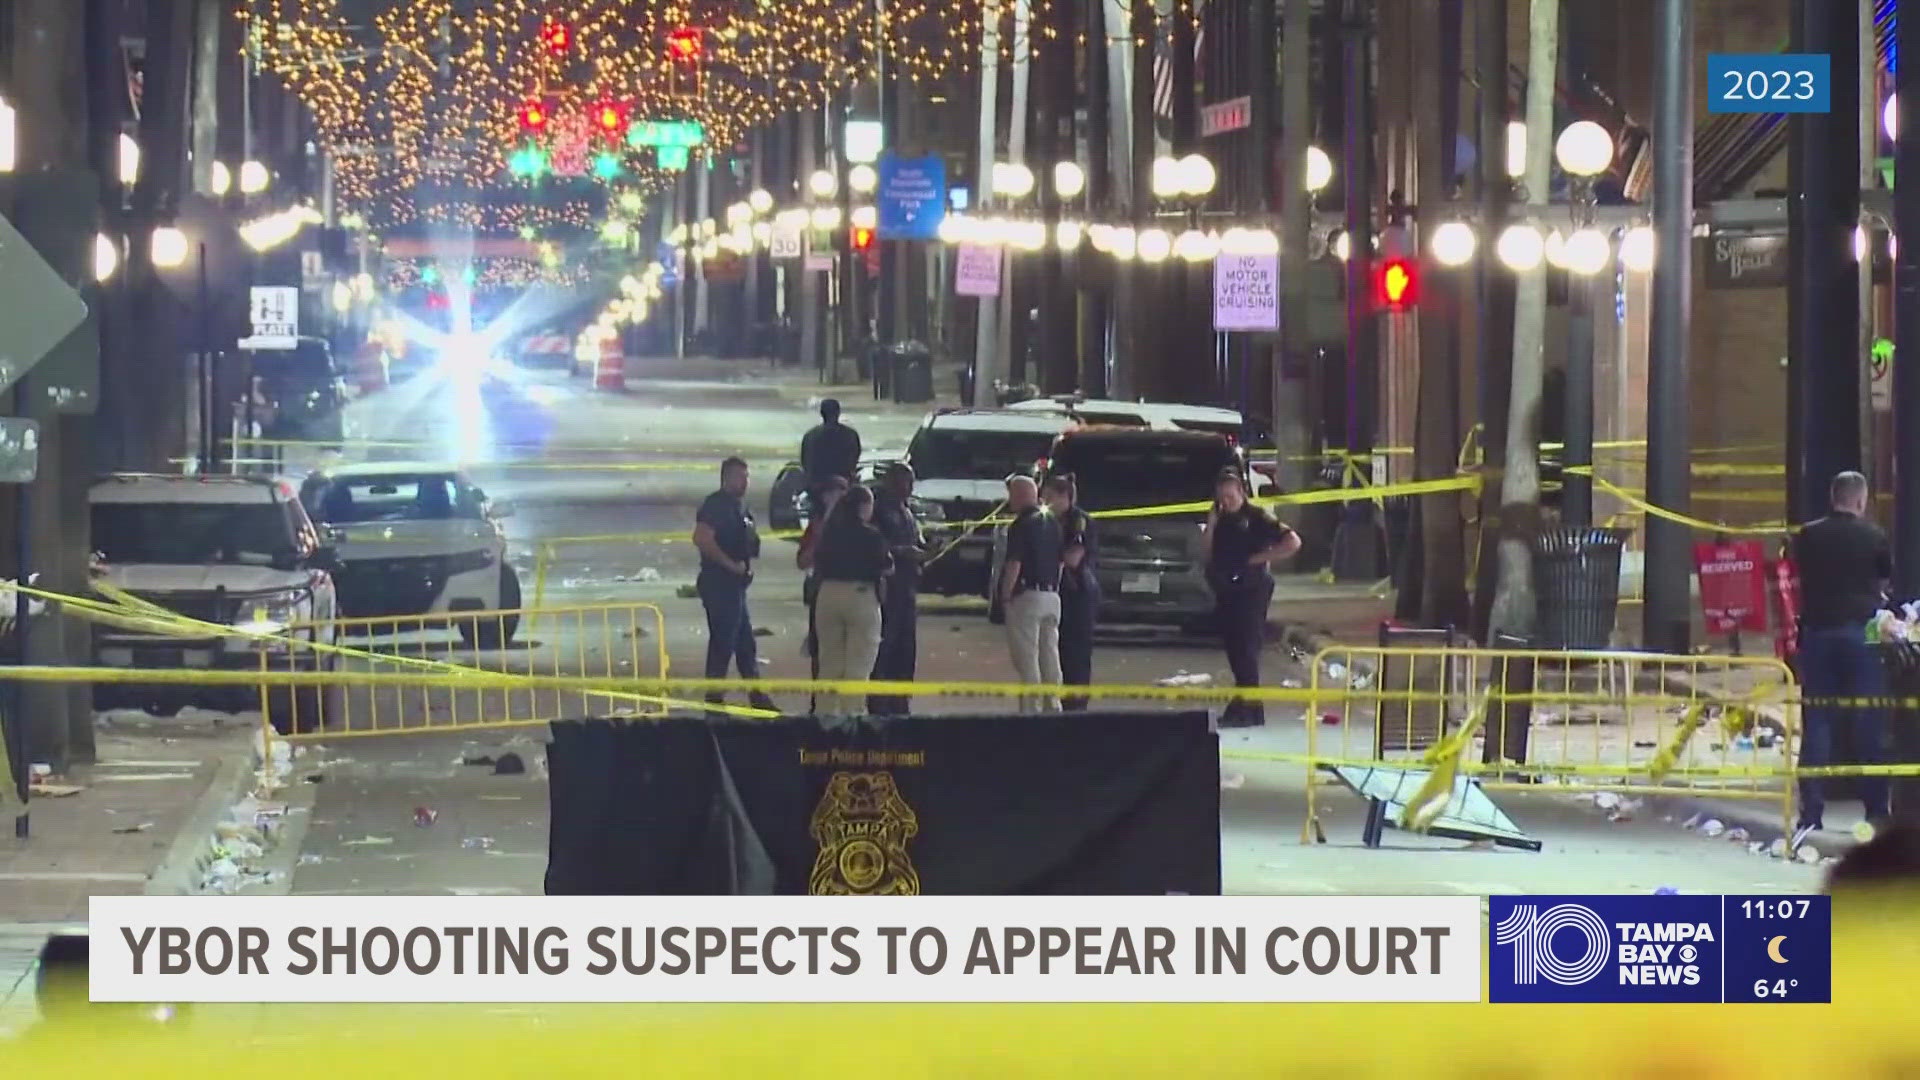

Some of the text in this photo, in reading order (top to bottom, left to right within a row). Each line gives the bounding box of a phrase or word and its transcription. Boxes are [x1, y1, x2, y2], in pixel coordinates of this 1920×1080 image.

[774, 240, 797, 254] 30
[1239, 256, 1256, 268] NO
[1226, 270, 1268, 281] MOTOR
[1222, 283, 1272, 295] VEHICLE
[1219, 297, 1274, 309] CRUISING
[1701, 561, 1753, 573] RESERVED
[838, 821, 888, 842] TAMPA
